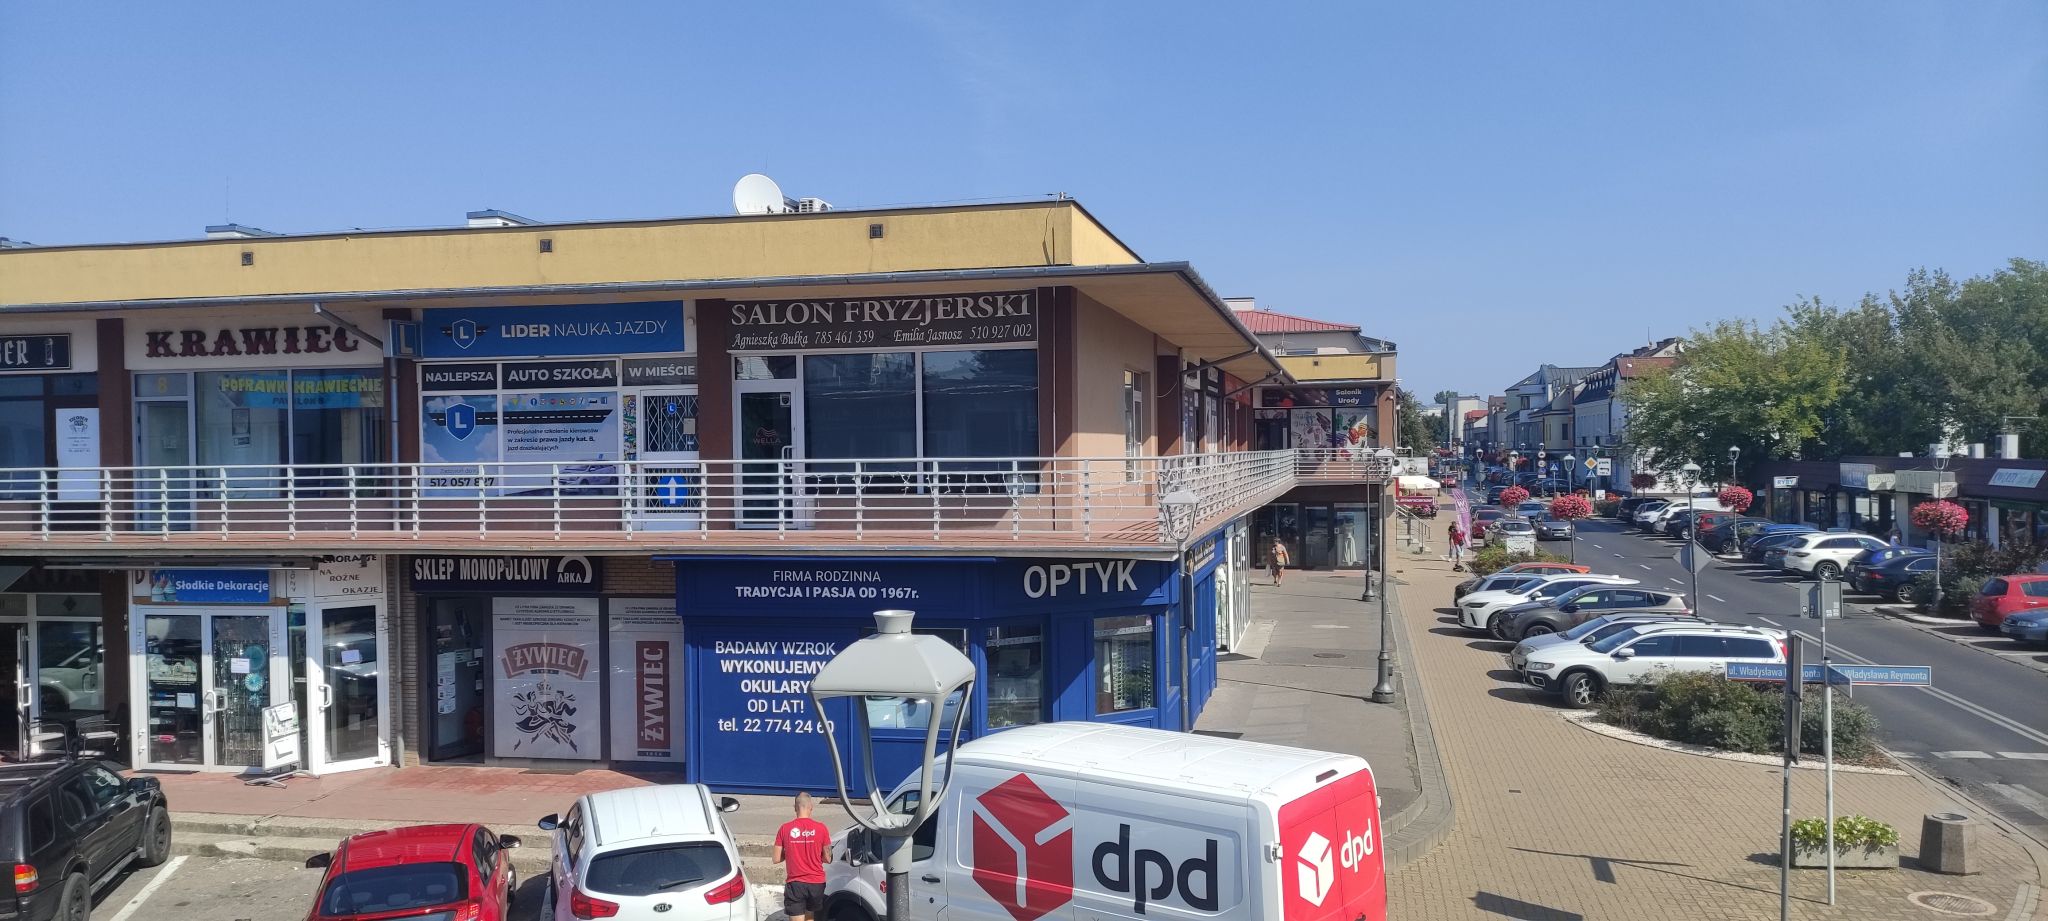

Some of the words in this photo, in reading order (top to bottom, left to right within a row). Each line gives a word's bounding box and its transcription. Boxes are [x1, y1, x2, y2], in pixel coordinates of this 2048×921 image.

[731, 302, 834, 326] SALON
[843, 293, 1032, 326] FRYZJERSKI
[459, 326, 469, 340] L
[501, 323, 550, 339] LIDER
[554, 321, 611, 337] NAUKA
[614, 319, 667, 336] JAZDY
[731, 332, 779, 349] Agnieszka
[780, 331, 809, 347] Bułka
[814, 330, 832, 345] 785
[834, 329, 853, 344] 461
[855, 329, 874, 344] 359
[893, 328, 926, 343] Emilia
[926, 327, 963, 344] Jasnosz
[970, 325, 990, 340] 510
[991, 324, 1011, 339] 927
[1013, 323, 1032, 338] 002
[146, 325, 359, 358] KRAWIEC
[0, 339, 29, 366] ER
[425, 371, 494, 384] NAJLEPSZA
[508, 369, 549, 382] AUTO
[552, 367, 613, 381] SZKOŁA
[629, 367, 644, 378] W
[645, 364, 696, 377] MIEŚCIE
[157, 377, 168, 395] 8
[1336, 388, 1362, 396] Salonik
[1338, 398, 1360, 406] Urody
[454, 411, 467, 429] L
[429, 477, 447, 487] 512
[450, 477, 471, 487] 057
[414, 558, 454, 581] SKLEP
[459, 557, 549, 581] MONOPOLOWY
[773, 570, 812, 582] FIRMA
[815, 570, 881, 582] RODZINNA
[557, 572, 583, 584] ARKA
[1023, 560, 1137, 600] OPTYK
[175, 580, 215, 591] Słodkie
[216, 580, 269, 593] Dekoracje
[342, 586, 379, 594] OKAZJE
[735, 586, 803, 598] TRADYCJA
[805, 586, 810, 598] I
[813, 586, 856, 599] PASJA
[858, 587, 877, 599] OD
[880, 587, 919, 599] 1967r.
[715, 641, 778, 655] BADAMY
[782, 641, 836, 656] WZROK
[512, 646, 578, 668] ŻYWIEC
[720, 659, 826, 674] WYKONUJEMY
[1728, 667, 1739, 676] ul.
[1740, 667, 1783, 679] Władysława
[1890, 670, 1928, 682] Reymonta
[740, 679, 812, 694] OKULARY
[641, 647, 664, 742] ŻYWIEC
[747, 699, 768, 713] OD
[772, 699, 804, 714] LAT!
[718, 717, 738, 732] tel.
[743, 718, 761, 732] 22
[764, 719, 792, 733] 774
[795, 719, 813, 733] 24
[816, 719, 835, 734] 60
[801, 828, 815, 838] dpd
[1341, 818, 1374, 873] dpd
[1092, 823, 1219, 915] dpd
